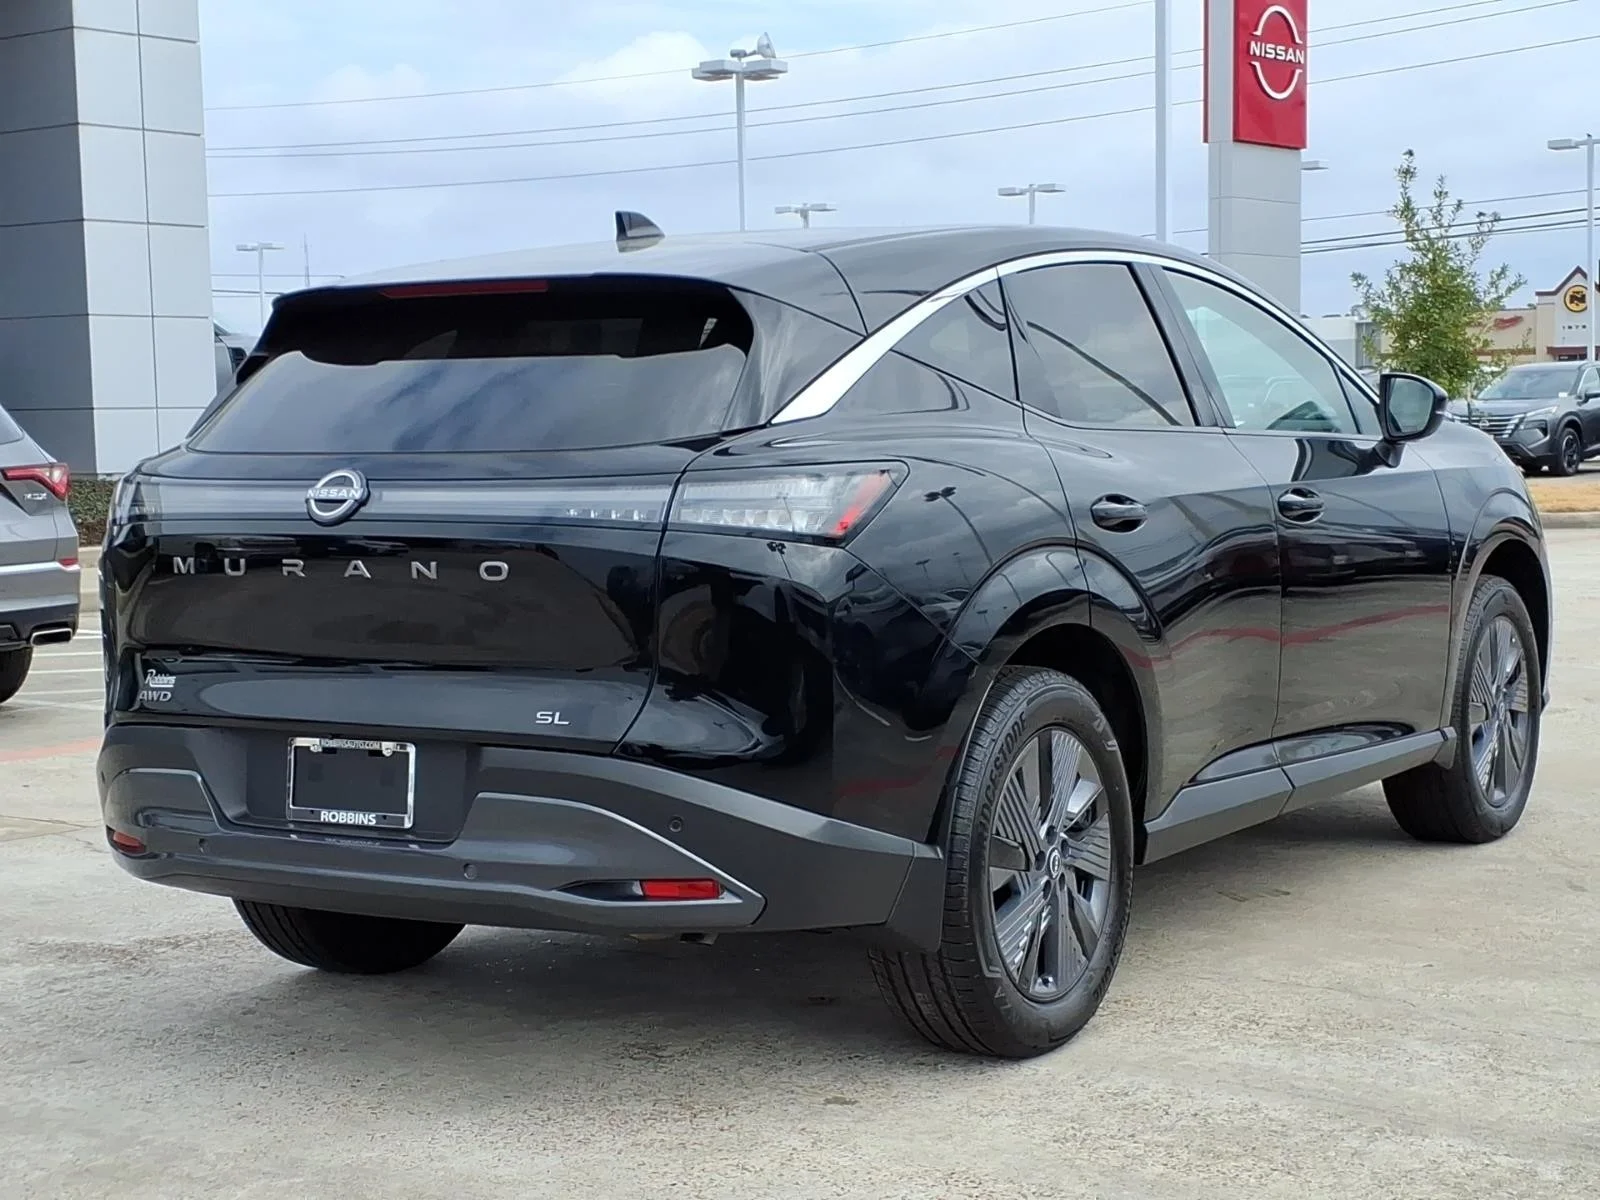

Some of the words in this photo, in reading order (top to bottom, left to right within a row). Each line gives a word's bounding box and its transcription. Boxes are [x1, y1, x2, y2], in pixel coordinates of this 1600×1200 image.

[1250, 41, 1304, 64] NISSAN
[307, 487, 363, 499] NISSAN
[173, 556, 509, 581] MURANO
[140, 690, 172, 702] AWD
[535, 711, 570, 725] SL
[320, 811, 377, 825] ROBBINS
